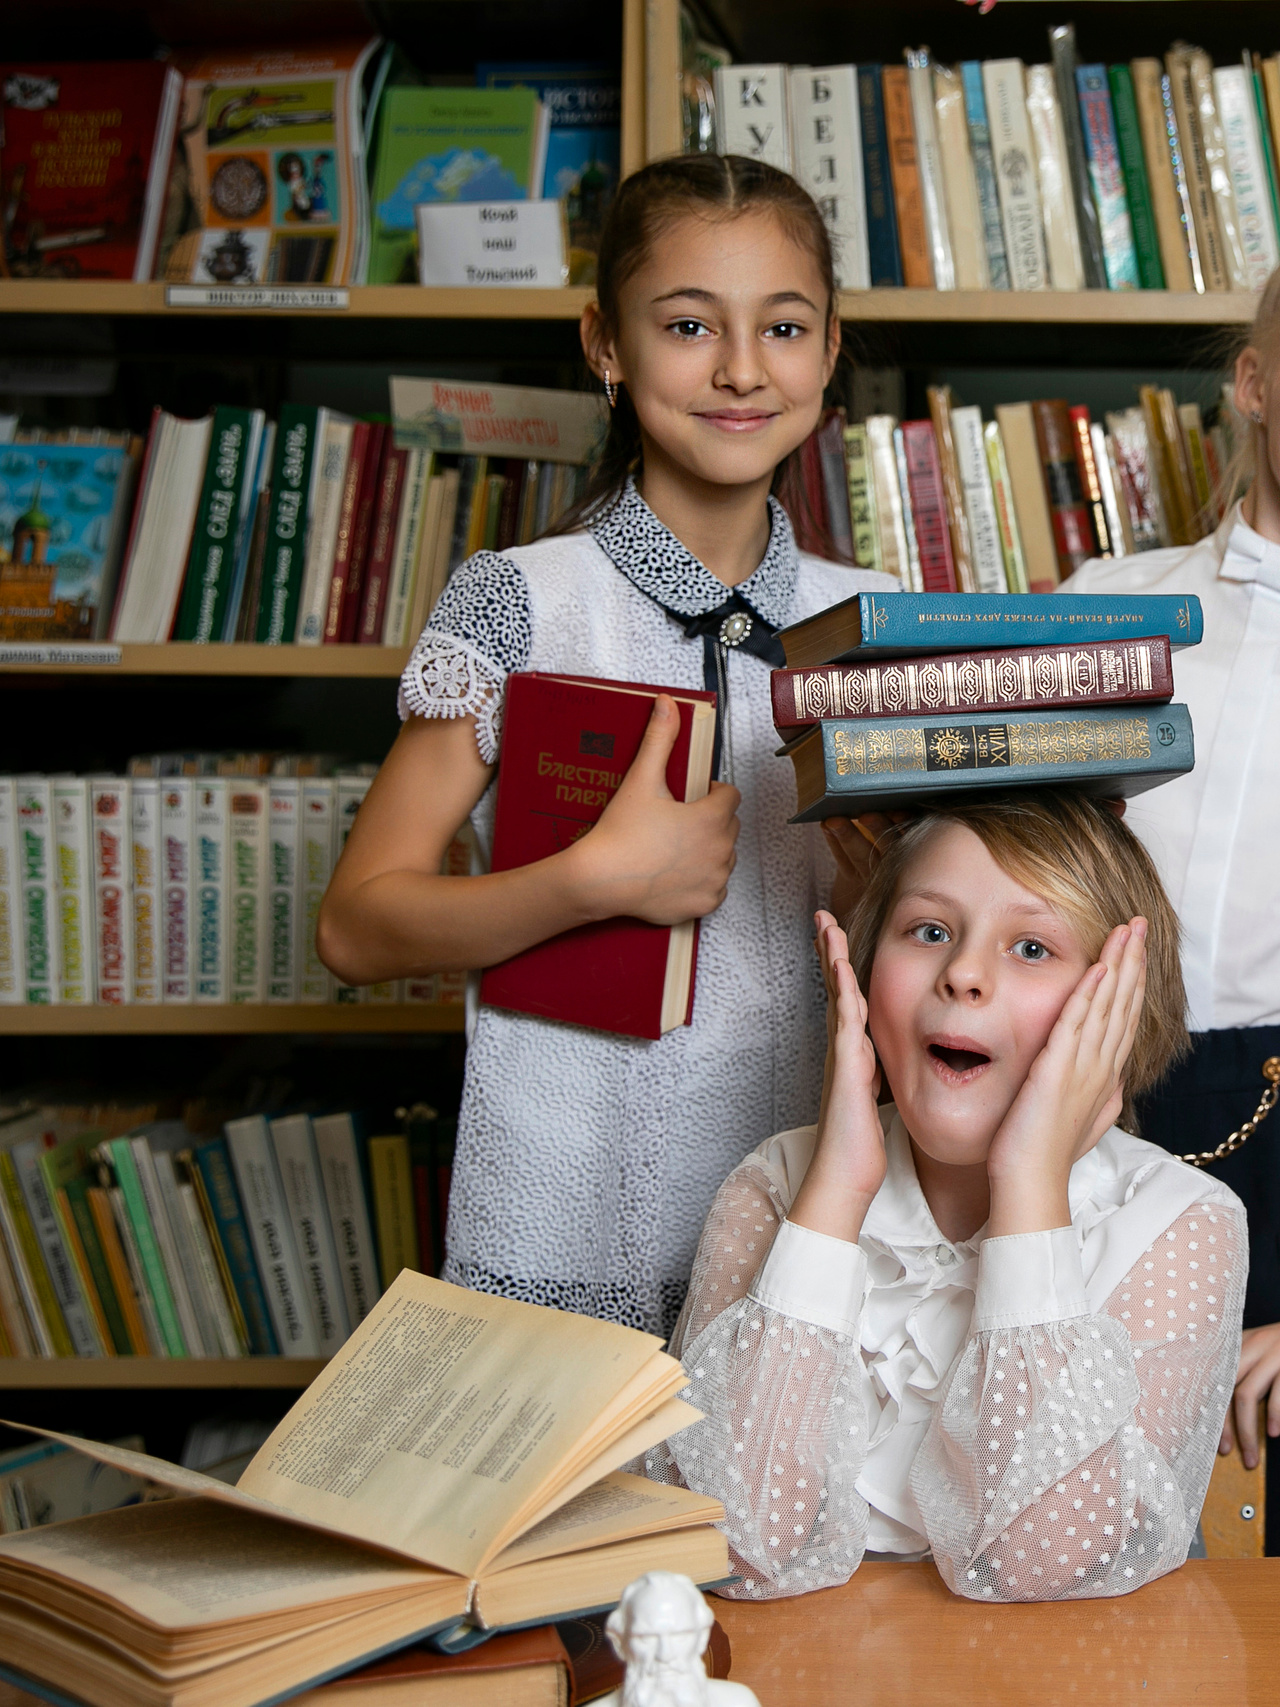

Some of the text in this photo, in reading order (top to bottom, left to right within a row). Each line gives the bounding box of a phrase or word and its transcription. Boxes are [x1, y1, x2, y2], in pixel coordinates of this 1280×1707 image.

[464, 264, 538, 284] Тульский
[918, 613, 972, 623] СТОЛЕТИЙ
[974, 613, 1001, 623] ДВУХ
[1004, 613, 1046, 623] РУБЕЖЕ
[1106, 614, 1144, 626] АНДРЕЙ
[1100, 649, 1111, 693] РОССИЙСКОГО
[1108, 650, 1118, 692] ГОСУДАРСТВА
[977, 734, 989, 758] ВЕК
[988, 727, 1007, 764] XVIII
[538, 752, 622, 789] Блестящ
[556, 784, 608, 808] плея
